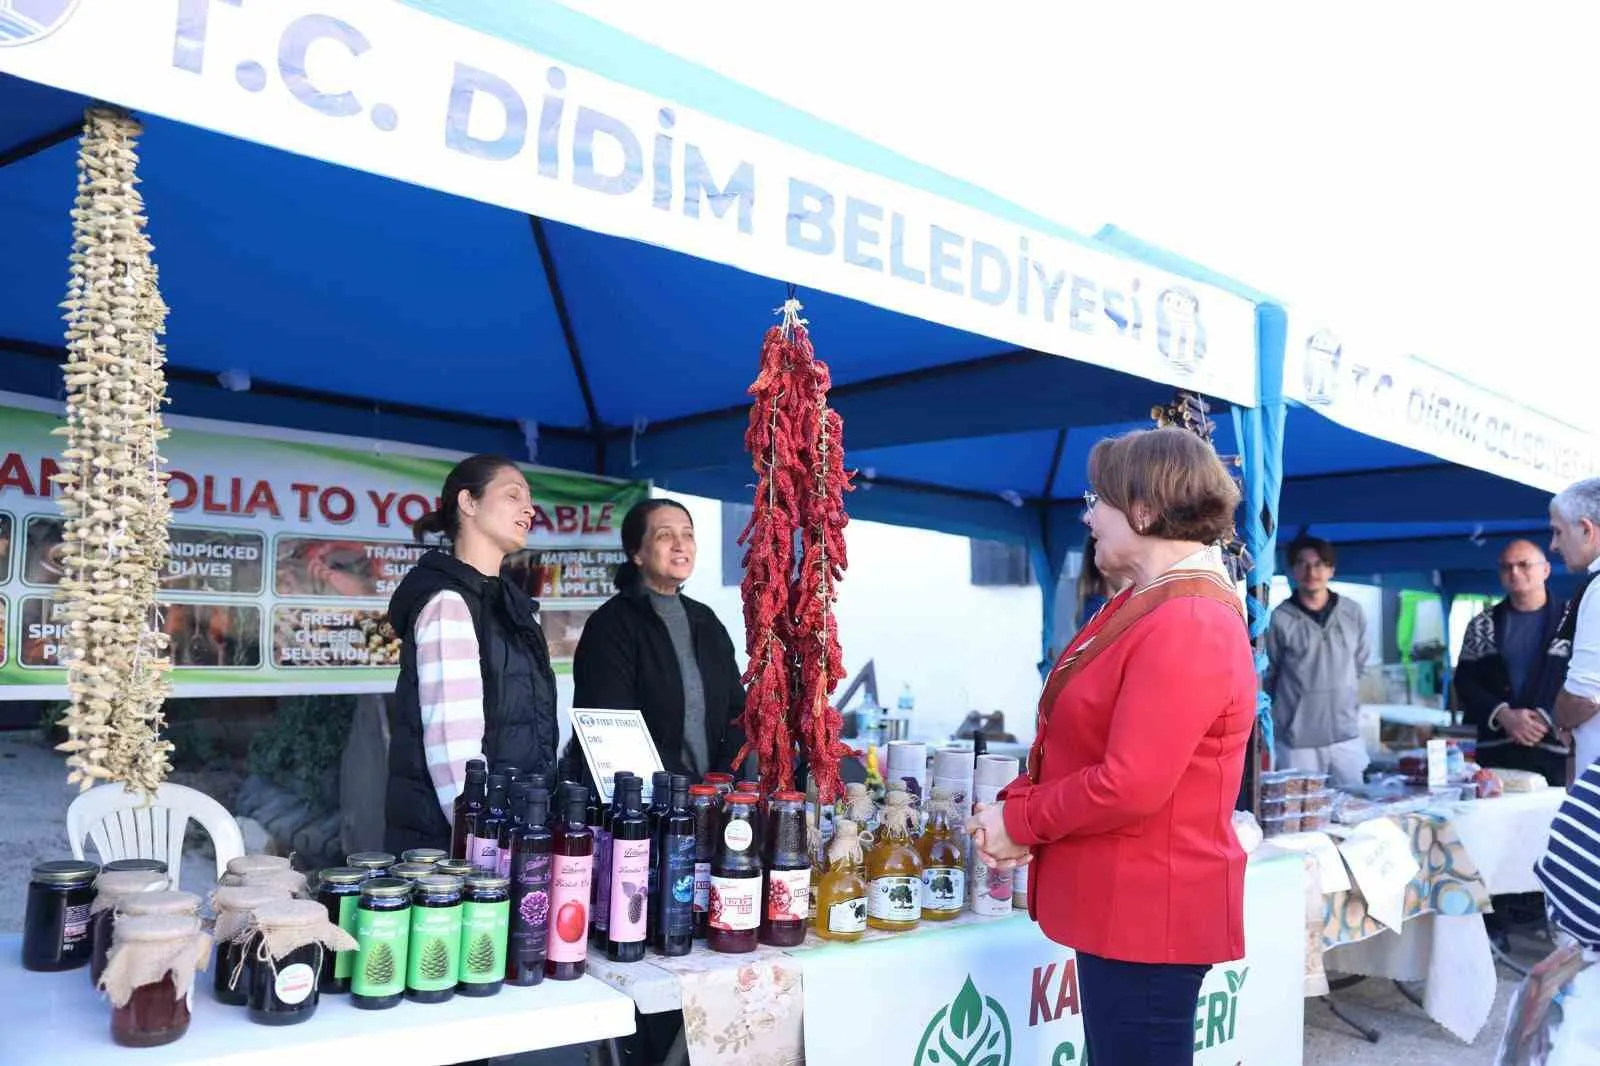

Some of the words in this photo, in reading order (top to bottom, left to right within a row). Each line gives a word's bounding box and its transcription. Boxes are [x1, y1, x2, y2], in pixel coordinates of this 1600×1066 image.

[445, 60, 756, 236] DİDİM
[785, 177, 1143, 342] BELEDİYESİ
[0, 452, 282, 519] ANOLIA
[291, 483, 355, 523] TO
[367, 490, 441, 527] YO
[529, 503, 615, 535] ABLE
[167, 541, 258, 561] NDPICKED
[167, 560, 233, 577] OLIVES
[563, 564, 607, 579] JUICES
[557, 582, 598, 594] APPLE
[302, 612, 354, 626] FRESH
[281, 647, 369, 661] SELECTION
